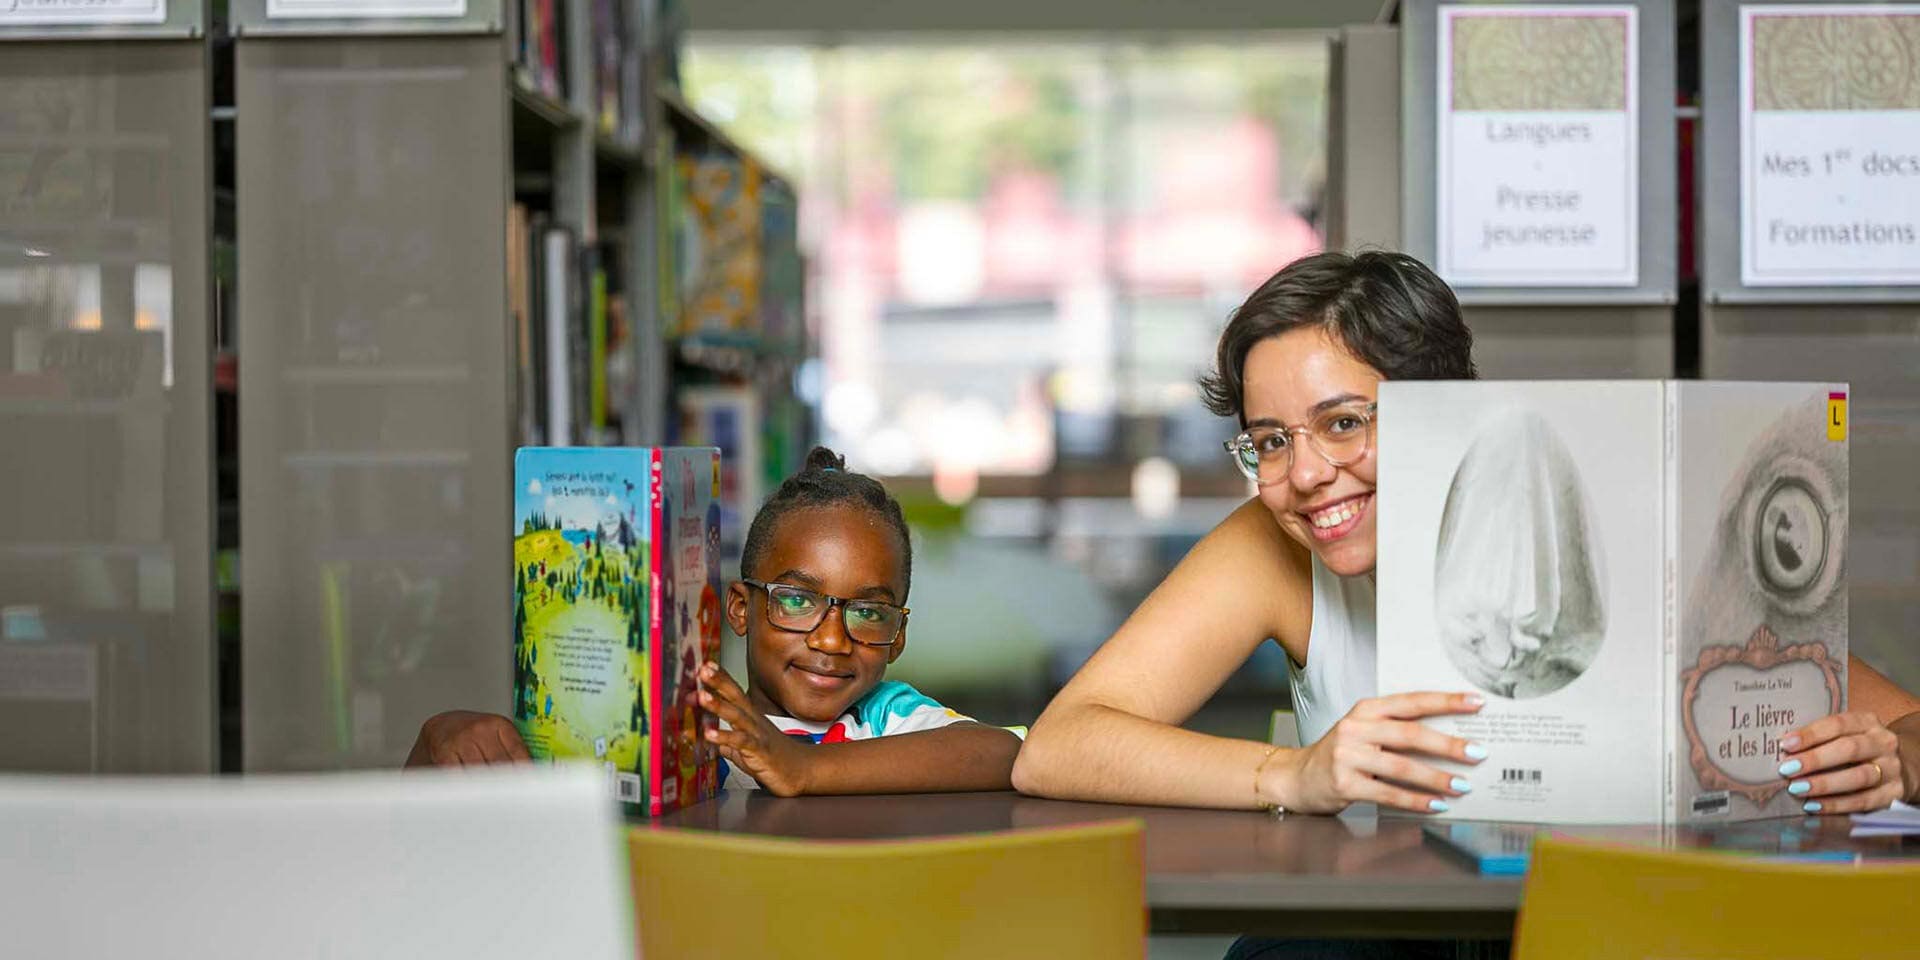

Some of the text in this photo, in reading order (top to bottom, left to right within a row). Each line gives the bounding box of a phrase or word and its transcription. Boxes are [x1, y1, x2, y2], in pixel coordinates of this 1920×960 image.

[1486, 118, 1592, 147] Langues
[1762, 152, 1811, 176] Mes
[1862, 151, 1920, 177] docs
[1497, 184, 1582, 210] Presse
[1482, 220, 1596, 249] jeunesse
[1769, 218, 1915, 245] Formations
[1833, 405, 1841, 426] L
[1731, 703, 1795, 730] Le lièvre
[1719, 738, 1732, 759] et
[1738, 733, 1758, 758] les
